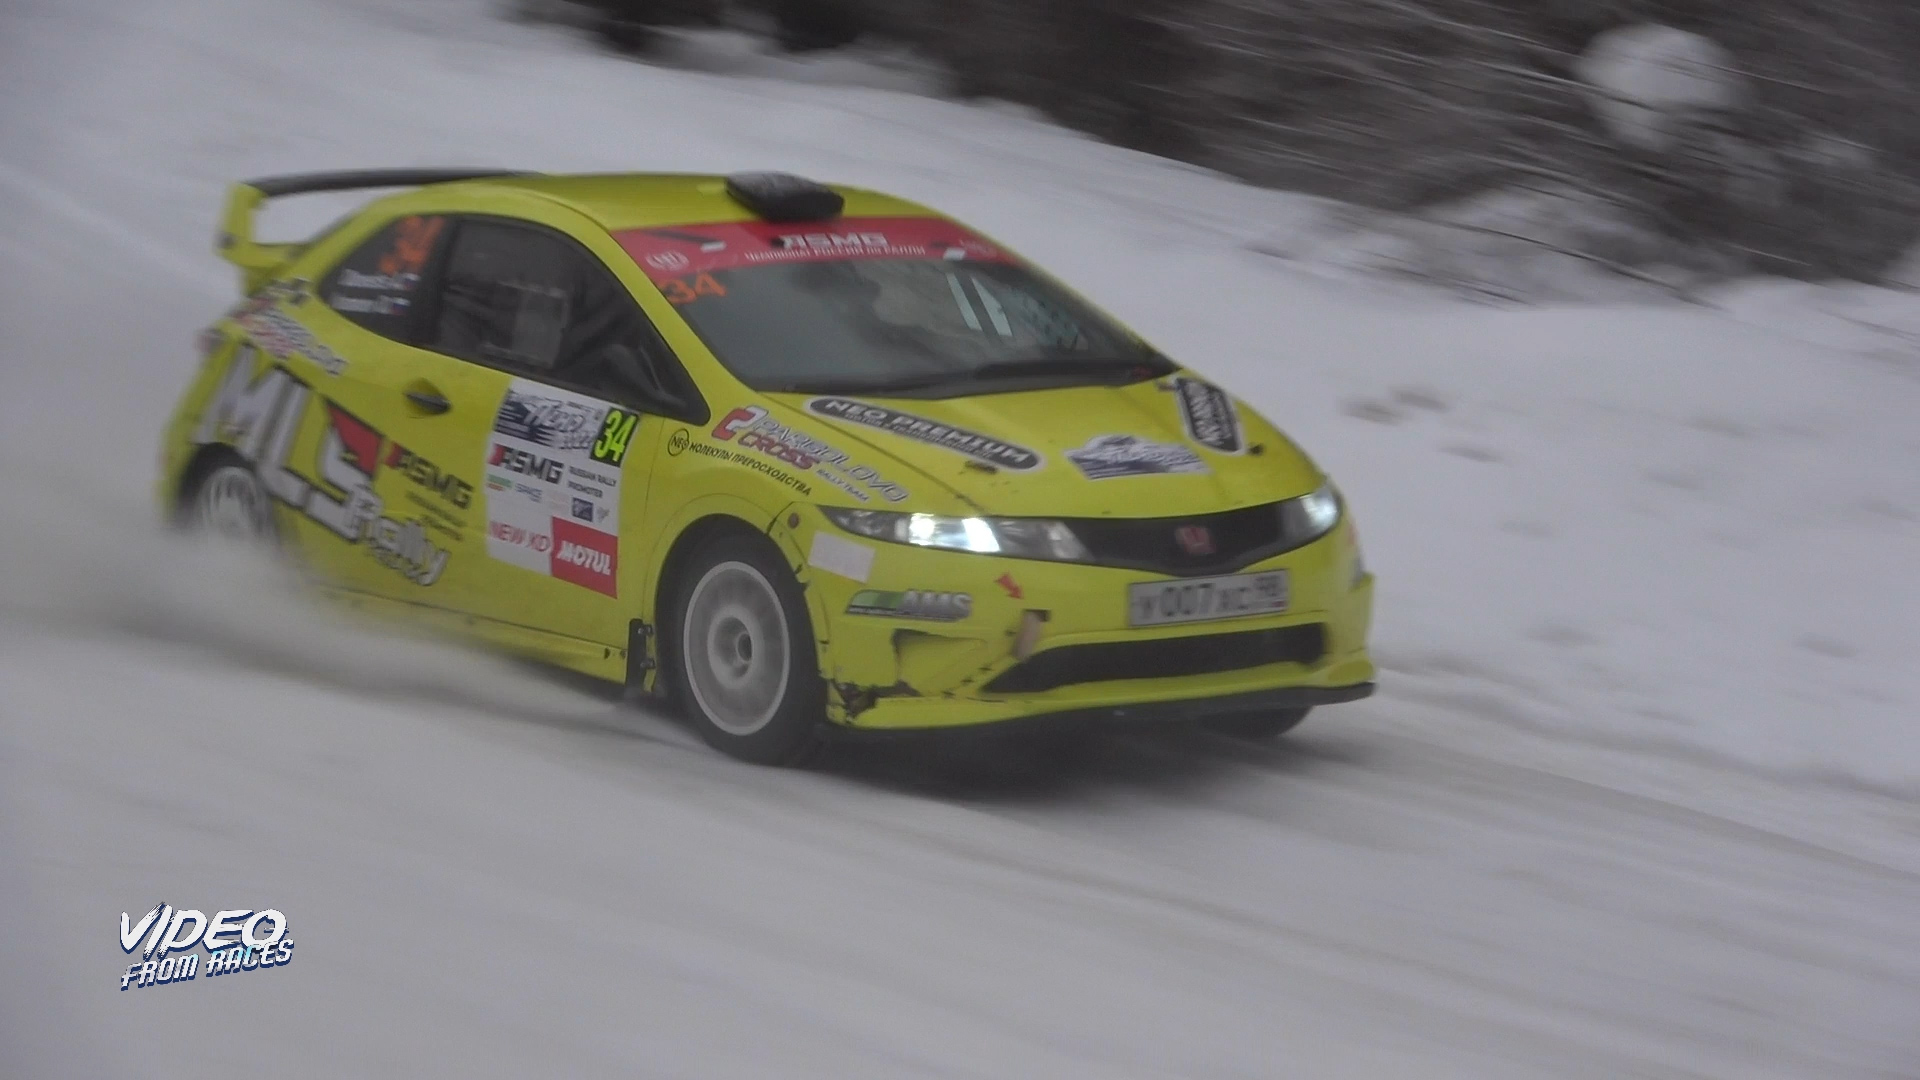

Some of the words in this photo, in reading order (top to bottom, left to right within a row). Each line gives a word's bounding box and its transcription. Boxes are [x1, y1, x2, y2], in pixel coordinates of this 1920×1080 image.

[659, 271, 727, 304] 34
[594, 409, 638, 462] 34
[825, 400, 888, 420] NEO
[891, 416, 1031, 463] PREMIUM
[689, 441, 732, 461] МОЛЕКУЛЫ
[737, 431, 820, 470] CROSS
[753, 416, 909, 503] PARGOLOVO
[557, 540, 611, 576] MOTUL
[899, 589, 973, 617] AMS
